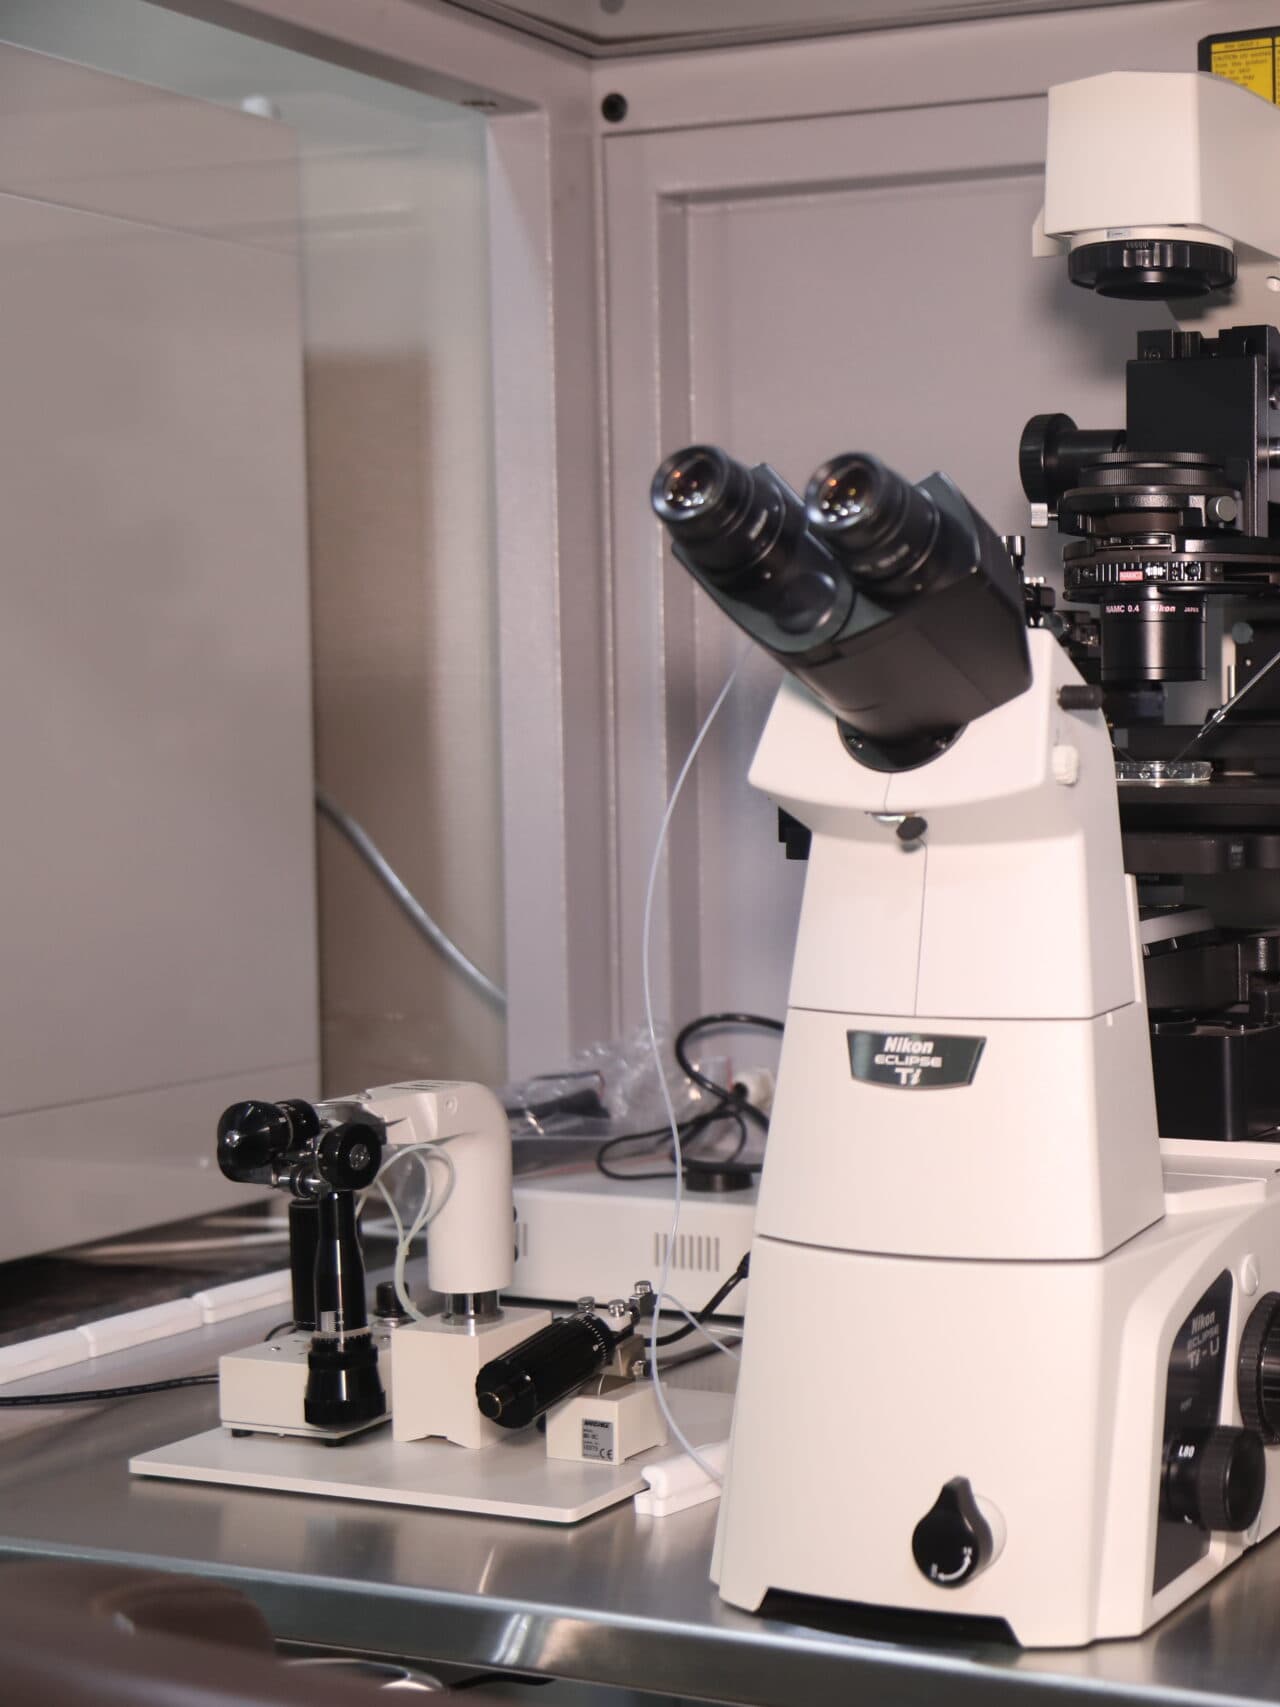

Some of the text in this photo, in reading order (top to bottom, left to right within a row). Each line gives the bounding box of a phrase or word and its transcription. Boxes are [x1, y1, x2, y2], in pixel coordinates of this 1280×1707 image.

[1127, 604, 1140, 613] 0.4
[884, 1035, 935, 1055] Nikon
[874, 1053, 943, 1068] ECLIPSE
[894, 1066, 922, 1086] Ti
[1192, 1311, 1216, 1335] Nikon
